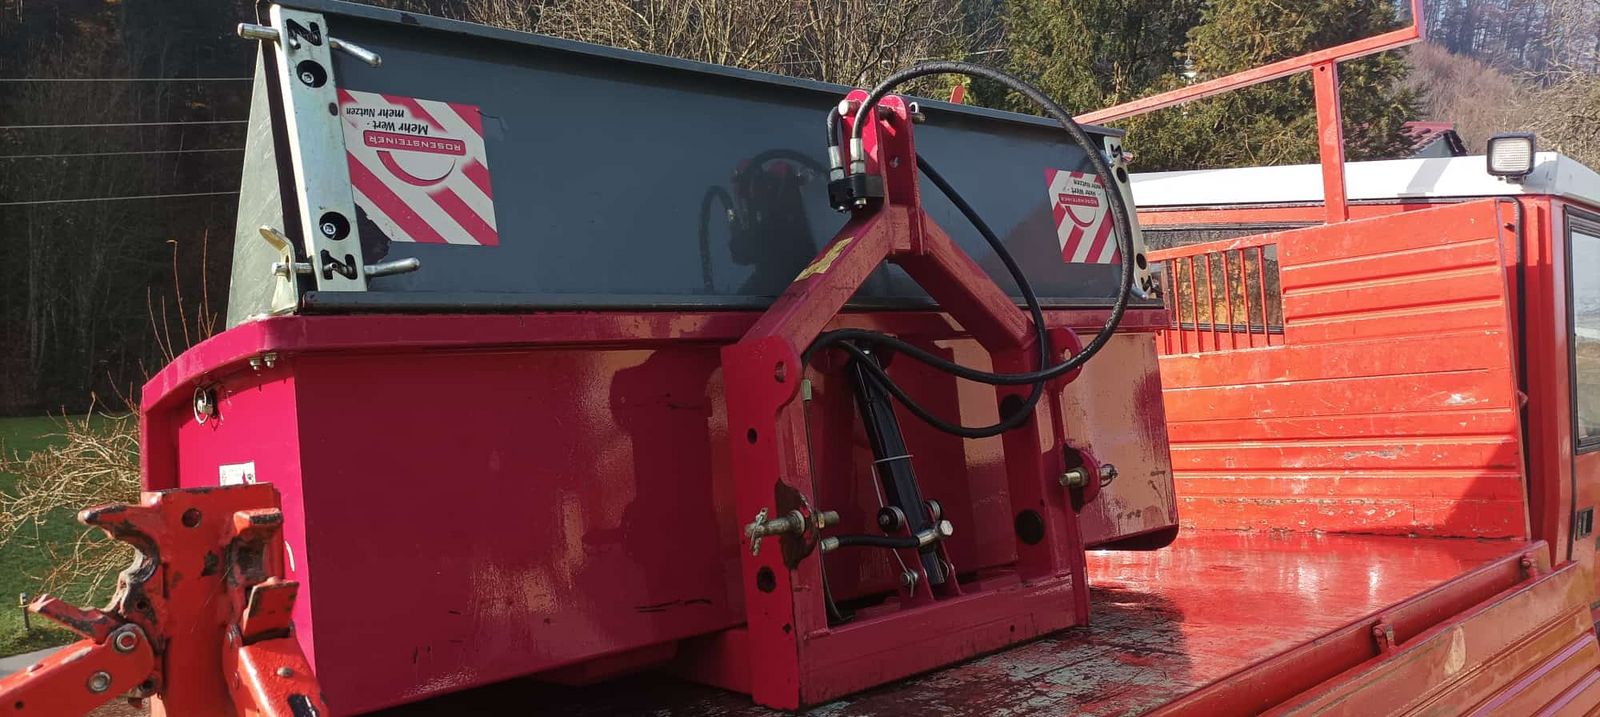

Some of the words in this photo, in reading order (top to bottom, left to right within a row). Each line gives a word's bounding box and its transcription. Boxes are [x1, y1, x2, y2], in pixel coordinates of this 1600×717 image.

[346, 107, 376, 117] Nutzen
[377, 108, 405, 119] mehr
[372, 120, 396, 131] Wert
[398, 123, 429, 135] Mehr
[368, 135, 462, 151] ROSENSTEINER
